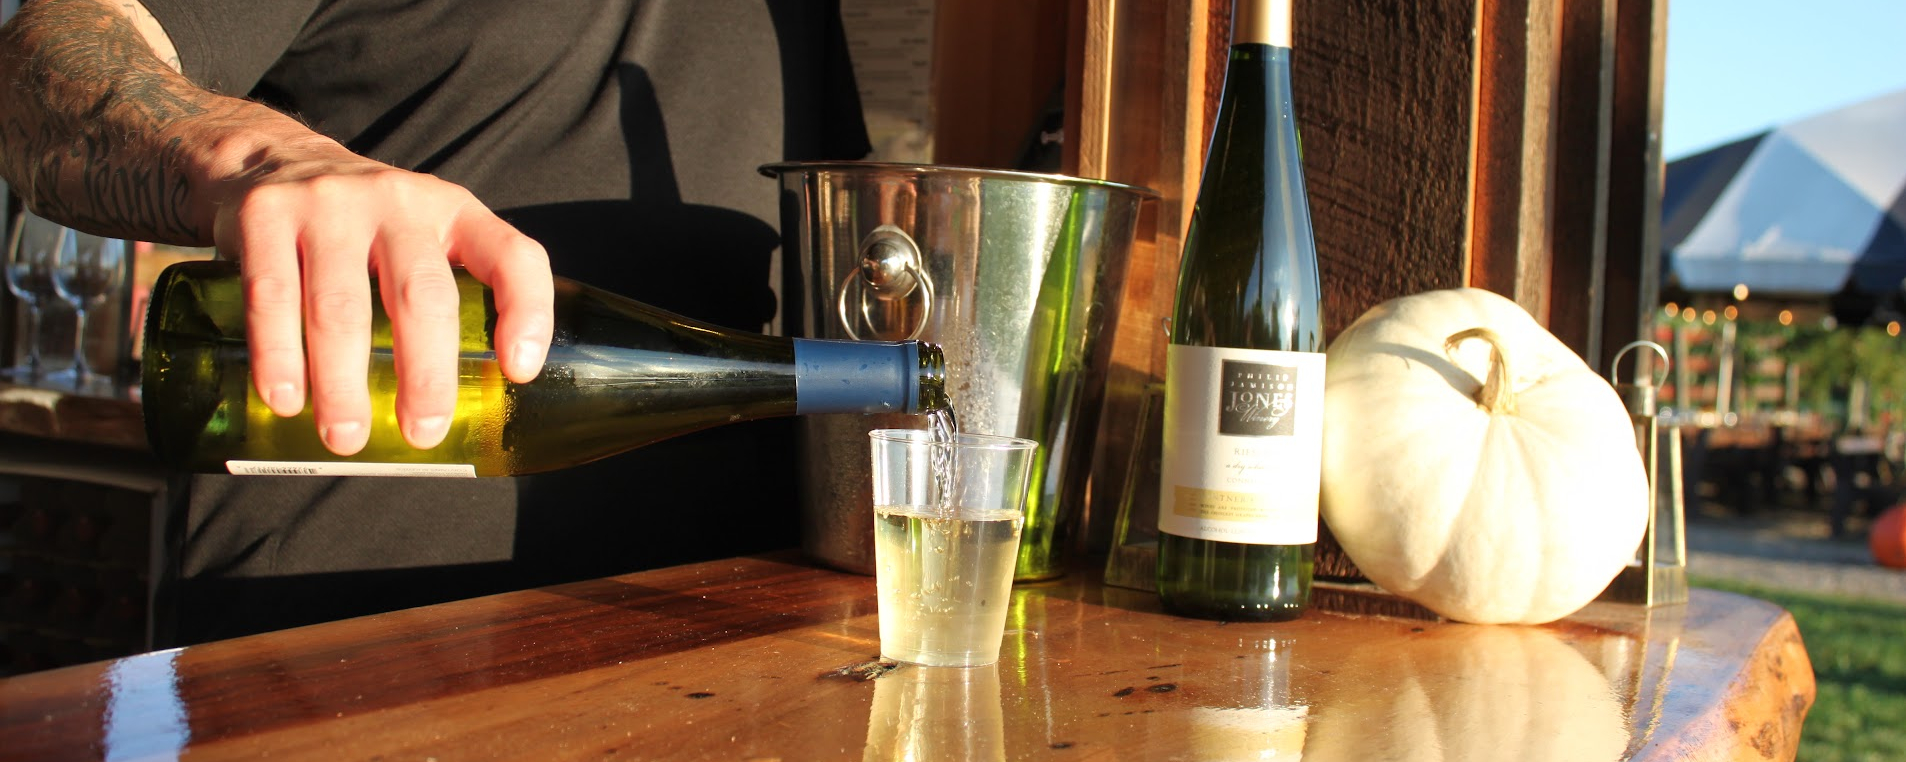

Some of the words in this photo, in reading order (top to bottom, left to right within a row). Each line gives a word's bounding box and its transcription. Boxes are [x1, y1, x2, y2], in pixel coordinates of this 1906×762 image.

[1237, 372, 1289, 381] PHILIP
[1230, 381, 1294, 391] JAMISON
[1225, 391, 1293, 412] JONES
[1235, 402, 1287, 430] Winery
